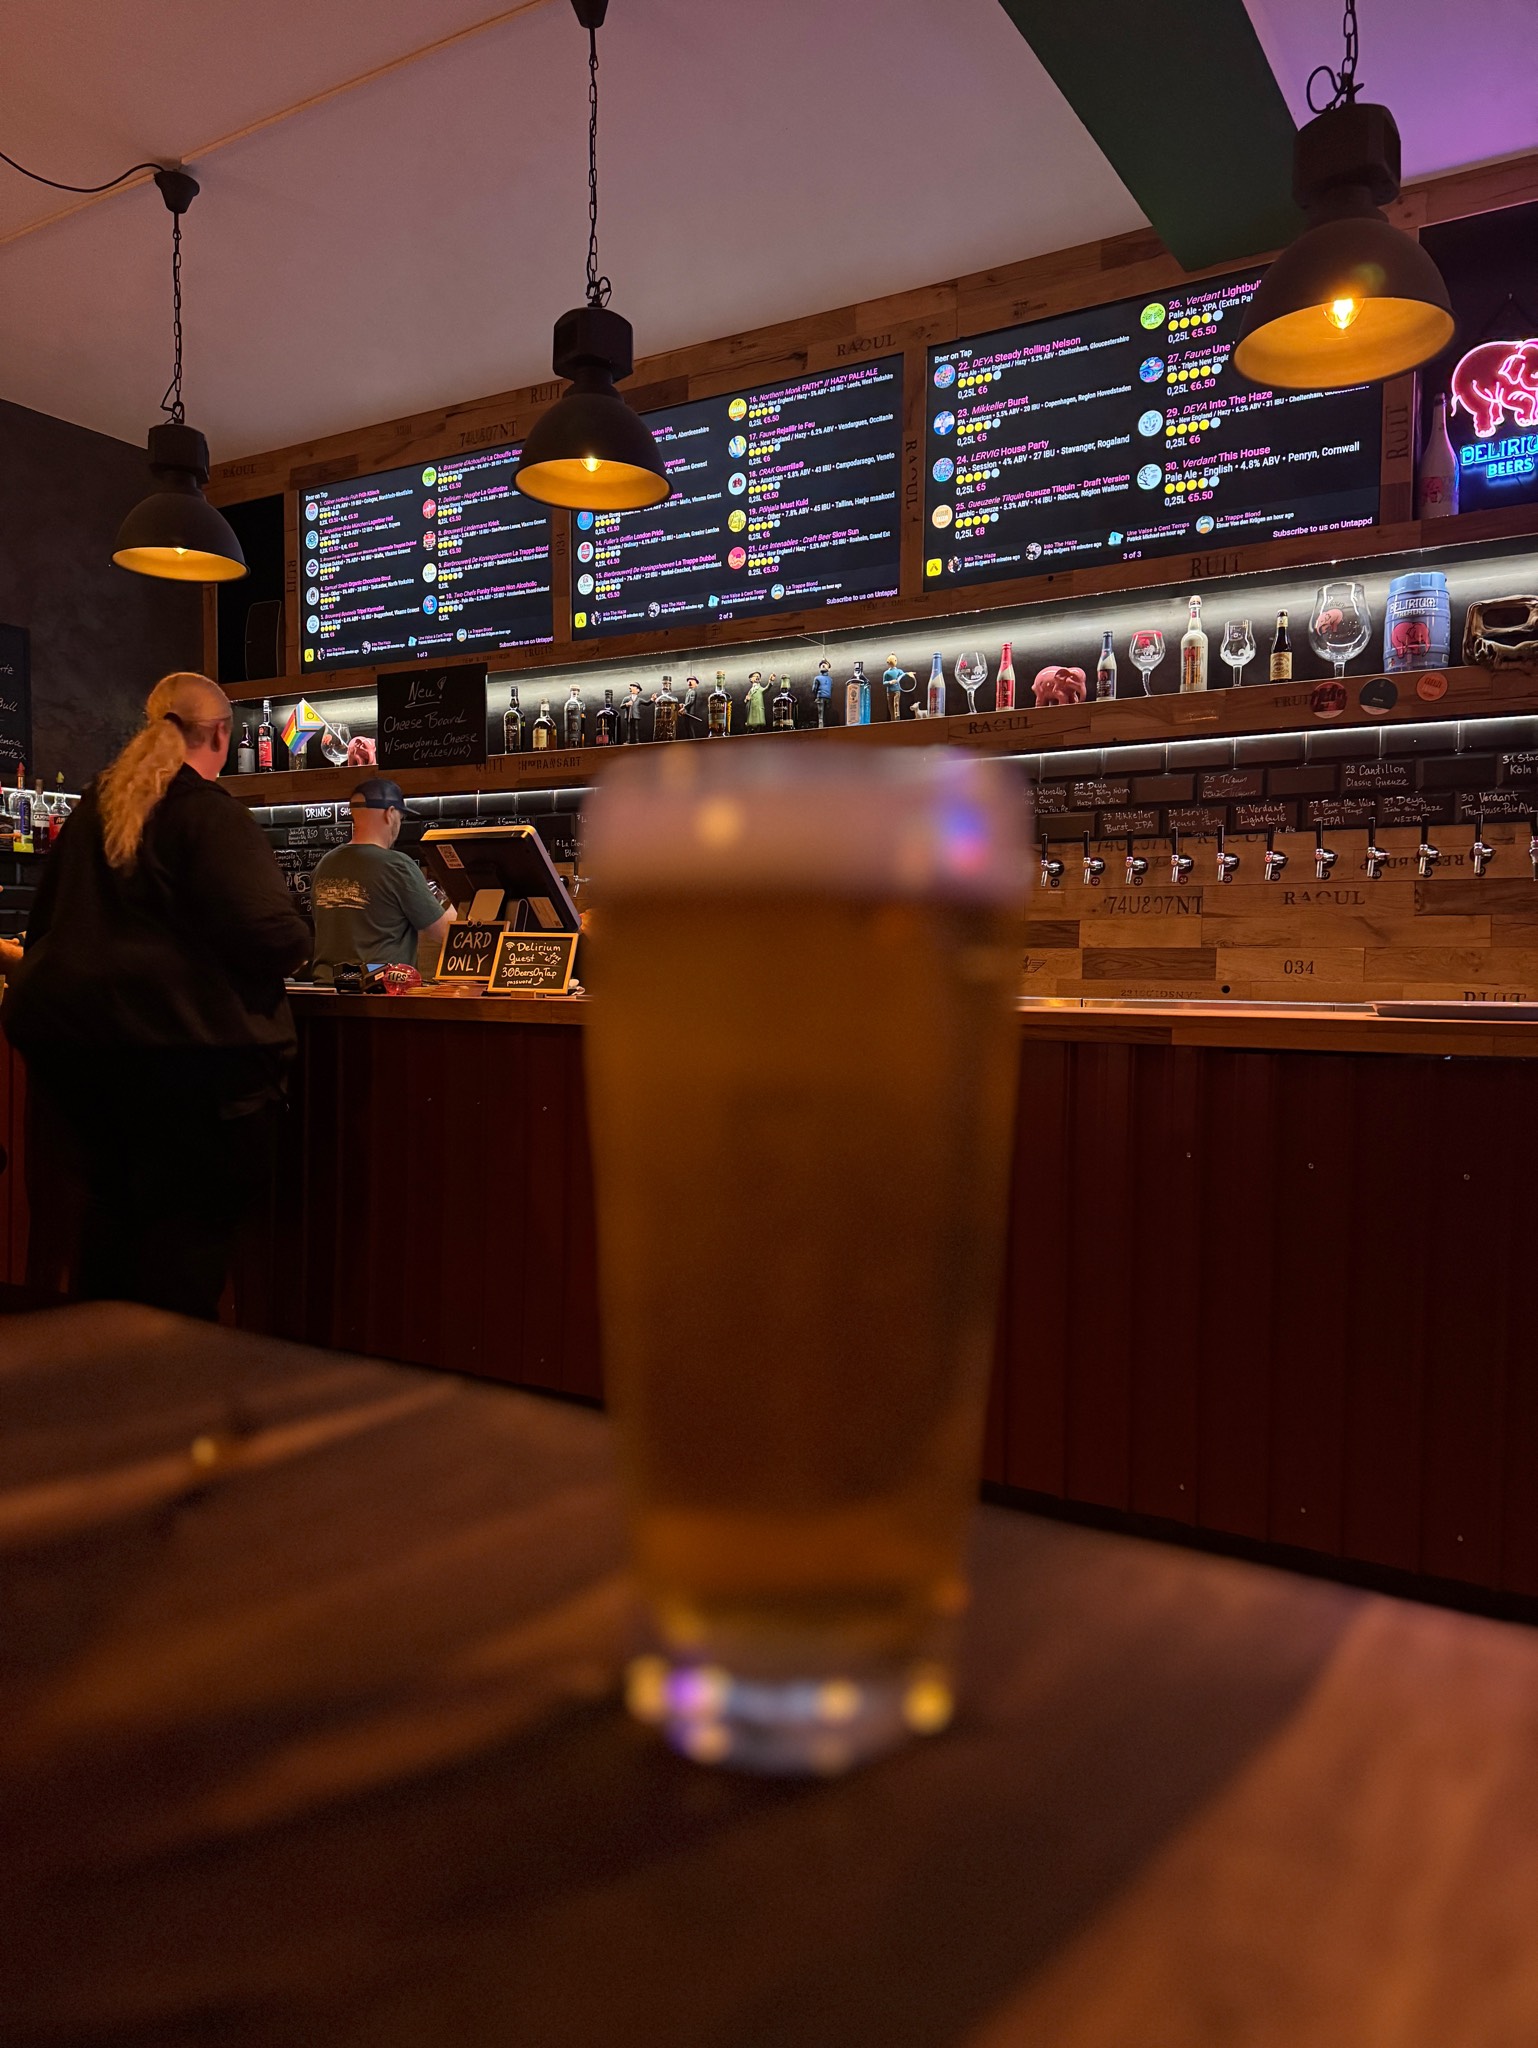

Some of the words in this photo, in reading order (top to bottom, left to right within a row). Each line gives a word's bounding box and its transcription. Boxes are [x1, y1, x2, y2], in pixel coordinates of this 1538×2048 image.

[1168, 298, 1182, 310] 26.
[1186, 289, 1220, 306] Verdant
[1222, 279, 1261, 299] Lightbul
[1167, 330, 1189, 344] 0,25L
[1191, 324, 1216, 339] €5.50
[837, 334, 896, 357] RAOUL
[958, 361, 969, 371] 22.
[972, 355, 992, 368] DEYA
[994, 348, 1021, 364] Steady
[1023, 342, 1050, 358] Rolling
[1052, 335, 1080, 349] Nelson
[1167, 353, 1181, 364] 27.
[1184, 346, 1210, 360] Fauve
[1212, 342, 1230, 354] Une
[934, 353, 949, 364] Beer
[959, 348, 972, 359] Tap
[830, 374, 847, 385] HAZY
[848, 370, 864, 381] PALE
[866, 367, 877, 377] ALE
[958, 387, 976, 399] 0,25L
[977, 385, 987, 395] €6
[1166, 383, 1188, 396] 0,25L
[1190, 378, 1215, 392] €6.50
[957, 408, 968, 418] 23.
[971, 400, 1006, 415] Mikkeller
[1007, 395, 1028, 407] Burst
[1166, 407, 1180, 418] 29.
[1183, 402, 1206, 414] DEYA
[1209, 398, 1226, 409] Into
[1228, 394, 1245, 406] The
[1248, 389, 1272, 402] Haze
[957, 435, 975, 446] 0,25L
[976, 432, 986, 442] €5
[1165, 436, 1186, 449] 0,25L
[1189, 434, 1200, 445] €6
[956, 454, 968, 464] 24.
[970, 448, 999, 461] LERVIG
[1001, 443, 1025, 456] House
[1028, 439, 1049, 453] Party
[1165, 461, 1179, 471] 30.
[1182, 454, 1216, 468] Verdant
[1218, 450, 1238, 462] This
[1240, 445, 1270, 458] House
[1165, 472, 1182, 483] Pale
[1184, 469, 1197, 480] Ale
[1204, 463, 1232, 478] English
[1240, 459, 1260, 470] 4.8%
[1262, 455, 1280, 466] ABV
[1288, 448, 1319, 464] Penryn,
[1321, 442, 1359, 456] Cornwall
[1487, 457, 1533, 477] BEERS
[956, 484, 974, 496] 0,25L
[976, 482, 985, 492] €5
[1083, 478, 1101, 488] Draft
[1102, 473, 1129, 485] Version
[1164, 494, 1186, 507] 0,25L
[1188, 490, 1213, 503] €5.50
[955, 529, 973, 540] 0,25L
[1272, 526, 1307, 538] Subscribe
[1310, 524, 1317, 532] to
[1340, 516, 1372, 530] Untappd
[1190, 551, 1244, 578] RUIT
[384, 716, 423, 733] Cheese
[424, 709, 468, 729] Board
[967, 717, 1034, 734] RAOUL
[442, 732, 479, 746] Cheese
[1359, 763, 1406, 776] Cantillon
[1510, 764, 1532, 775] Köln
[1479, 790, 1519, 802] Verdant
[305, 807, 333, 819] DRINKS
[1248, 802, 1286, 813] Verdant
[1135, 820, 1154, 830] IPA
[1283, 890, 1366, 905] RAOUL
[453, 931, 492, 949] CARD
[517, 942, 561, 952] Delirium
[447, 953, 489, 973] ONLY
[1284, 960, 1315, 975] 034
[506, 977, 533, 987] password
